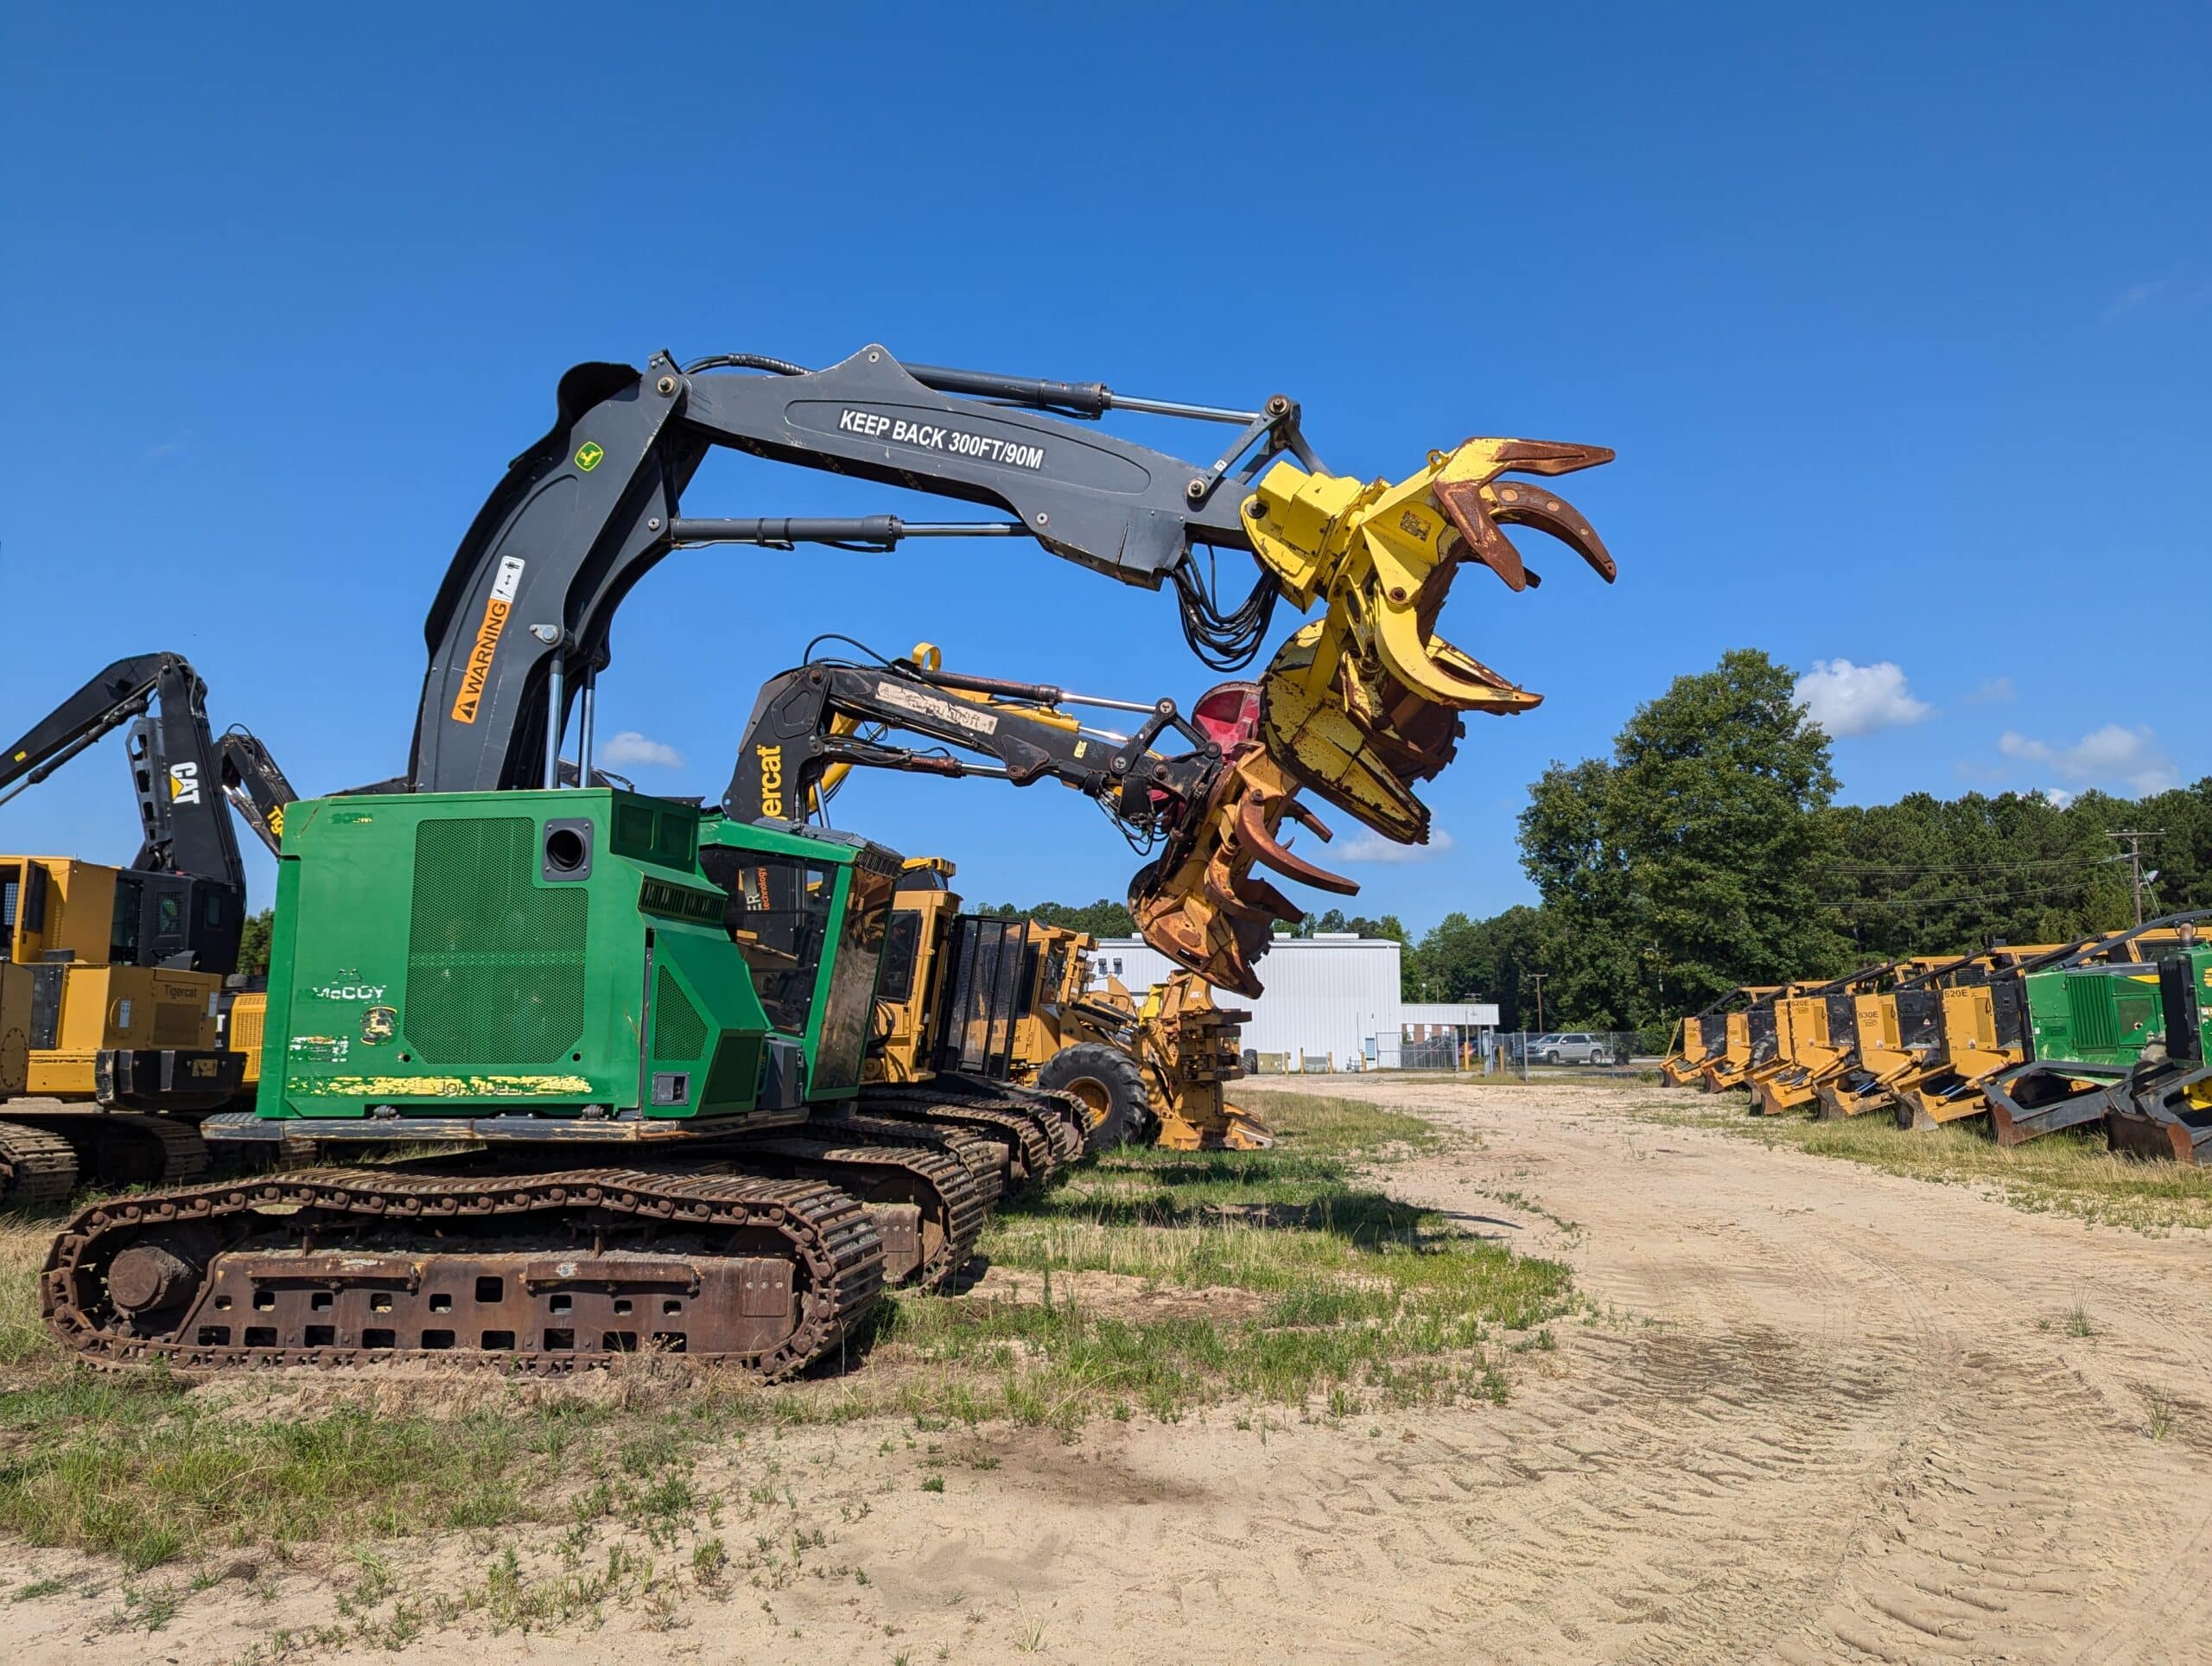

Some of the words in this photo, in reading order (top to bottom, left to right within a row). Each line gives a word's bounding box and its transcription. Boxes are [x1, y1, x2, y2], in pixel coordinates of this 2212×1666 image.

[839, 409, 890, 436] KEEP
[892, 420, 947, 449] BACK
[949, 431, 1044, 469] 300FT/90M
[465, 602, 506, 695] WARNING
[169, 761, 200, 804] CAT
[757, 744, 788, 821] ercat
[267, 804, 283, 838] Tig
[757, 867, 771, 911] technology
[164, 984, 197, 999] Tigercat
